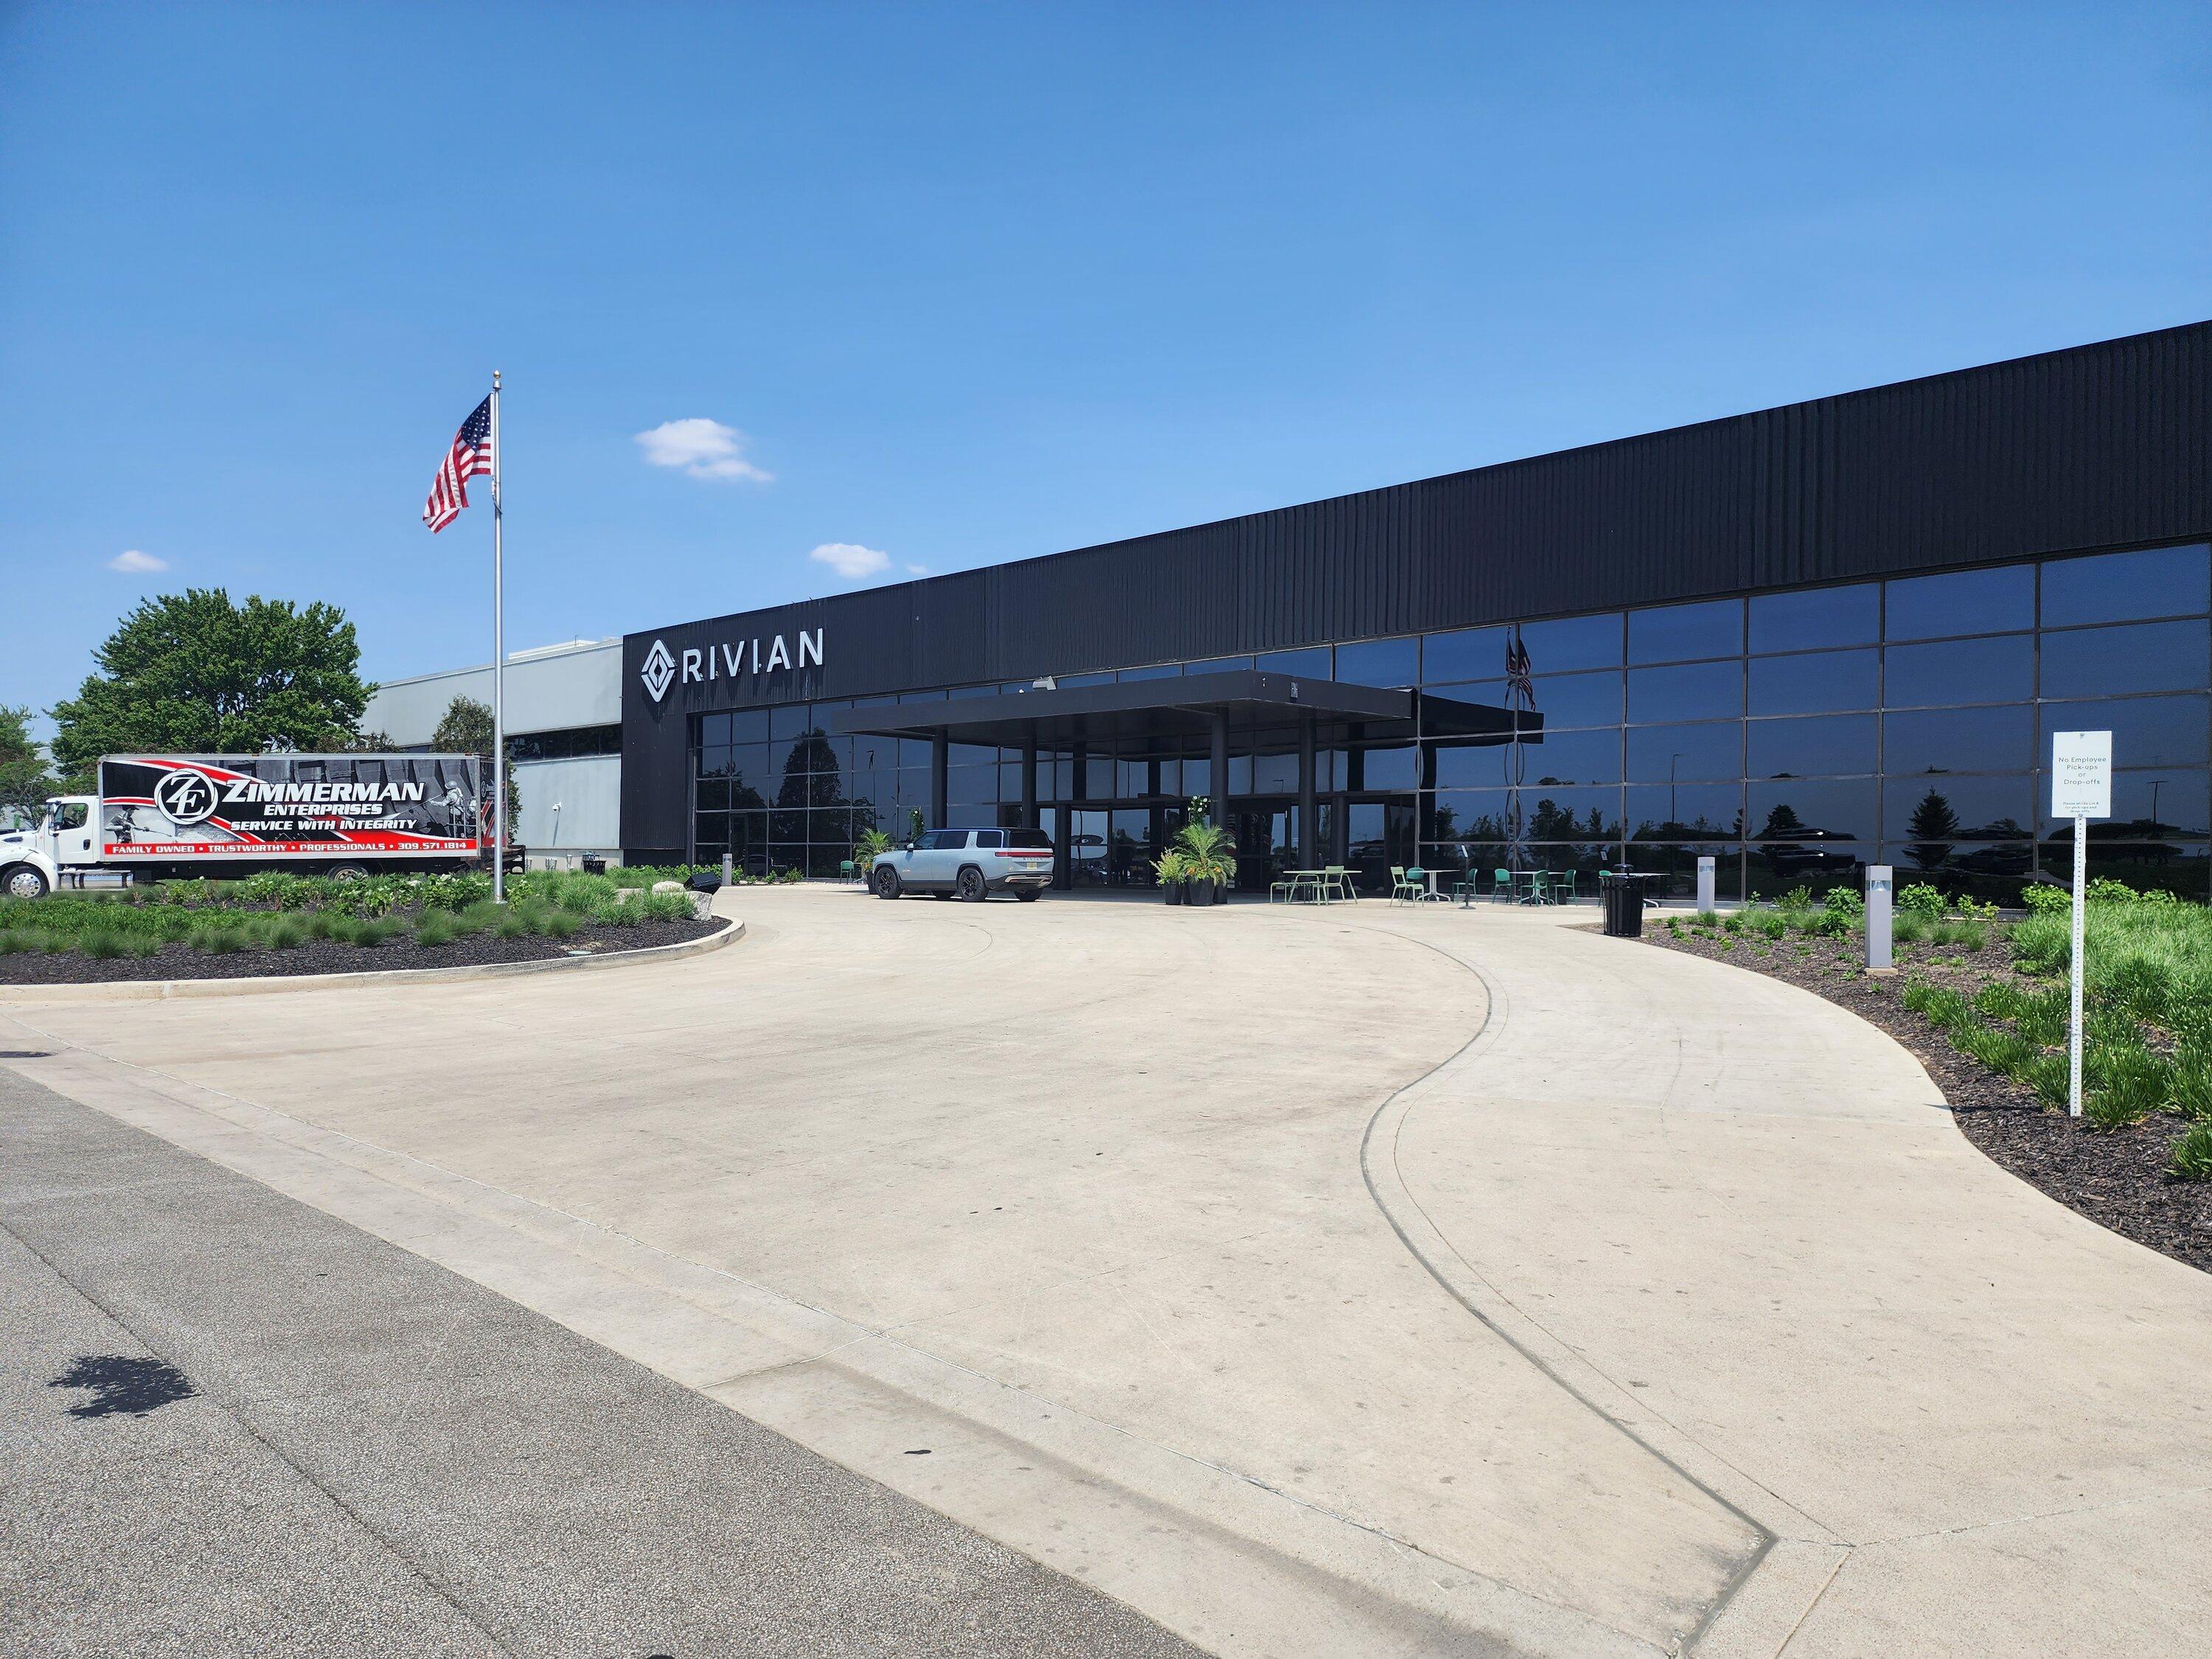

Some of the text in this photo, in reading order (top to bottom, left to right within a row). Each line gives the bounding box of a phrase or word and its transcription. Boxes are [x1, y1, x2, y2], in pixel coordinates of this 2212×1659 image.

[682, 627, 824, 684] RIVIAN
[222, 779, 425, 803] ZIMMERMAN
[263, 804, 383, 816] ENTERPRISES
[230, 819, 417, 831] SERVICE WITH INTEGRITY
[112, 846, 152, 854] FAMILY
[207, 844, 288, 852] TRUSTWORTHY
[299, 843, 386, 852] PROFESSIONALS
